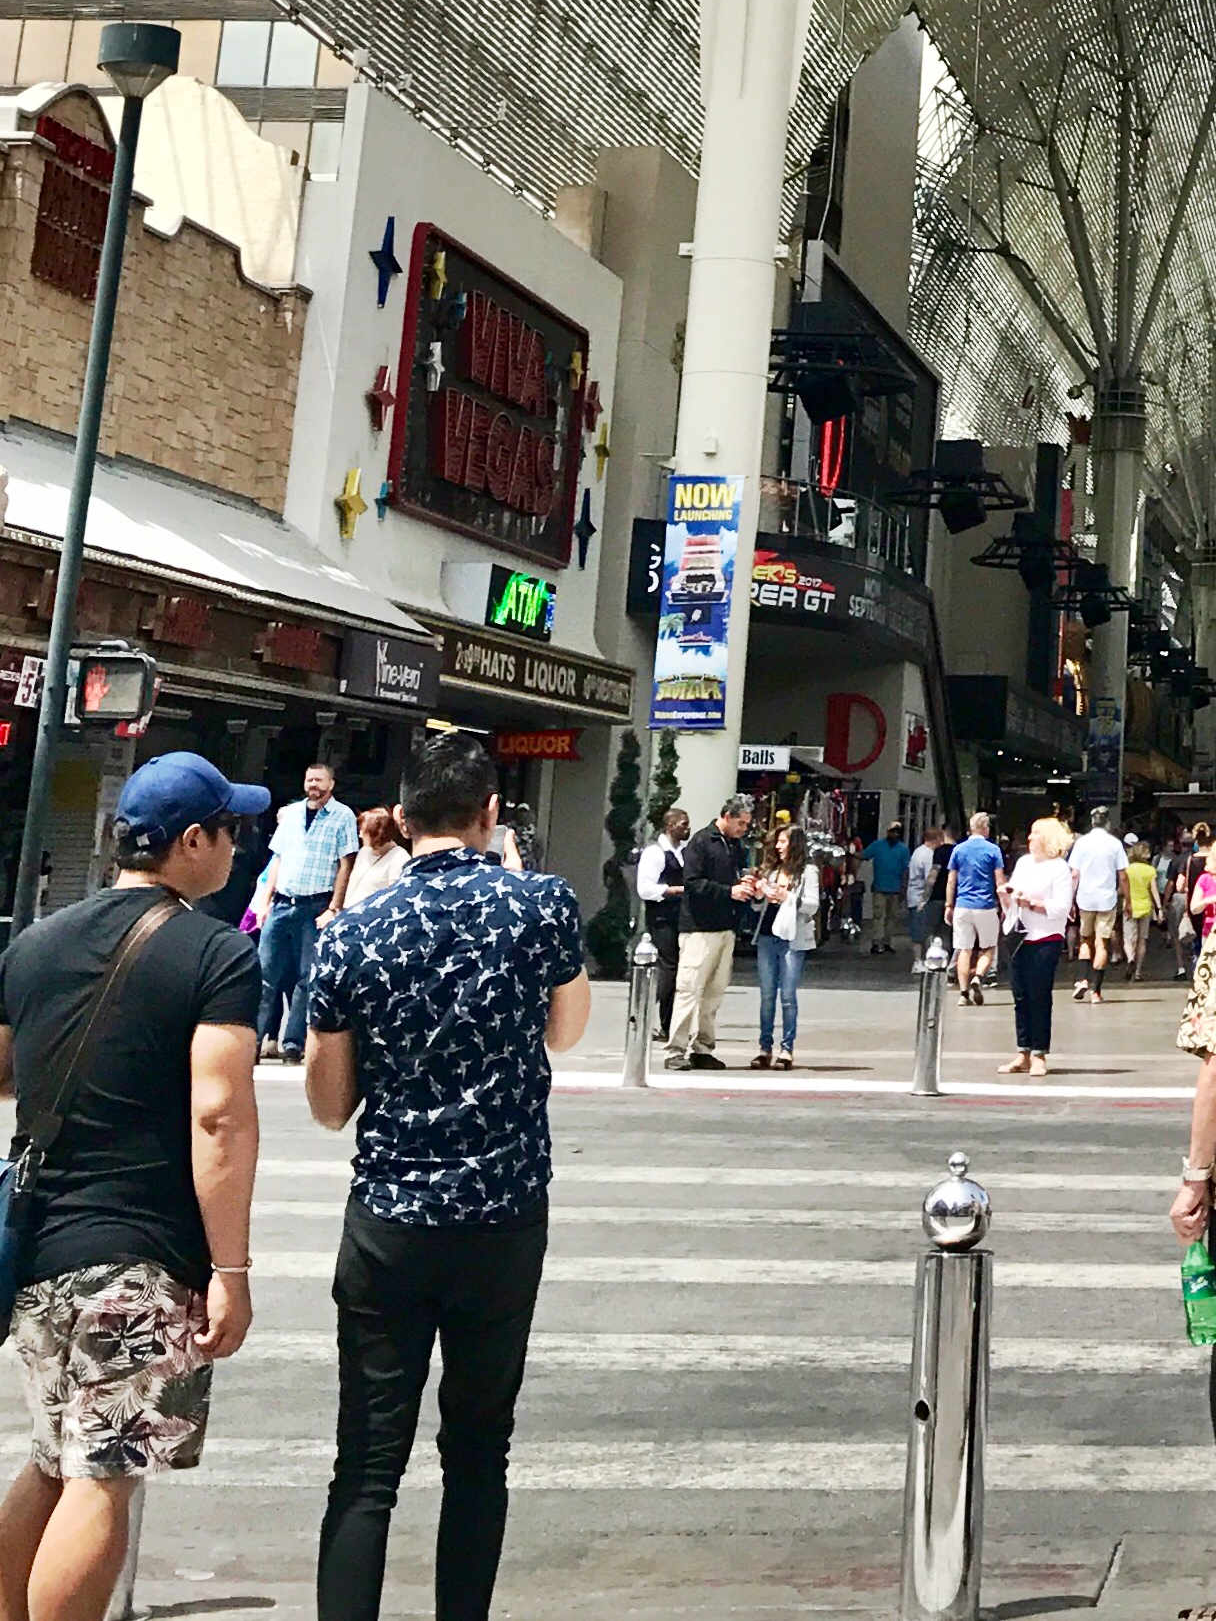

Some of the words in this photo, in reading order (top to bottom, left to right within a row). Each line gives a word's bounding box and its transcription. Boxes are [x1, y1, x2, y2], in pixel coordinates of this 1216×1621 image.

[457, 289, 548, 420] VIVA
[430, 387, 556, 517] VEGAS
[674, 483, 736, 508] NOW
[674, 509, 732, 522] LAUNCHING
[798, 576, 822, 587] 2017
[804, 591, 836, 613] GT
[480, 649, 516, 683] HATS
[524, 658, 577, 697] LIQUOR
[498, 733, 570, 754] LIQUOR
[825, 693, 886, 773] D
[741, 749, 775, 766] Balls
